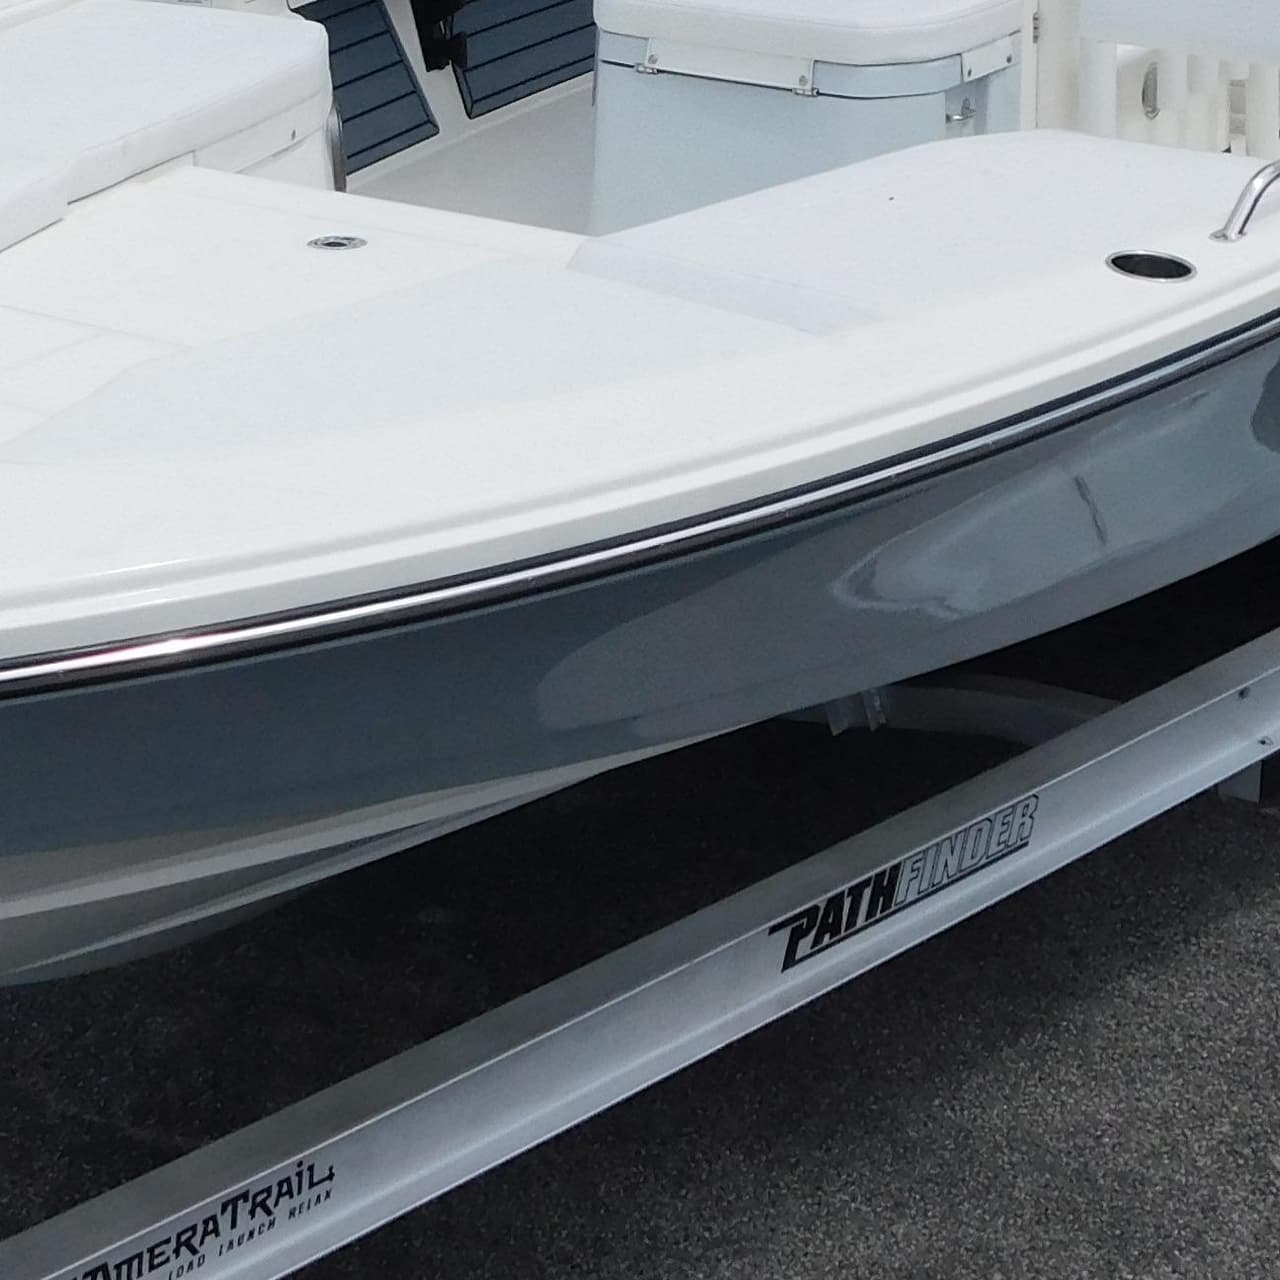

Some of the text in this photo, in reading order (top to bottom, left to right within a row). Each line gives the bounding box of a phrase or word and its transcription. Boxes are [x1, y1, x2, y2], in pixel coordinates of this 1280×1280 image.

[768, 793, 1039, 974] PATHFINDER
[218, 1217, 277, 1257] LAUNCH
[287, 1188, 333, 1221] RELAX
